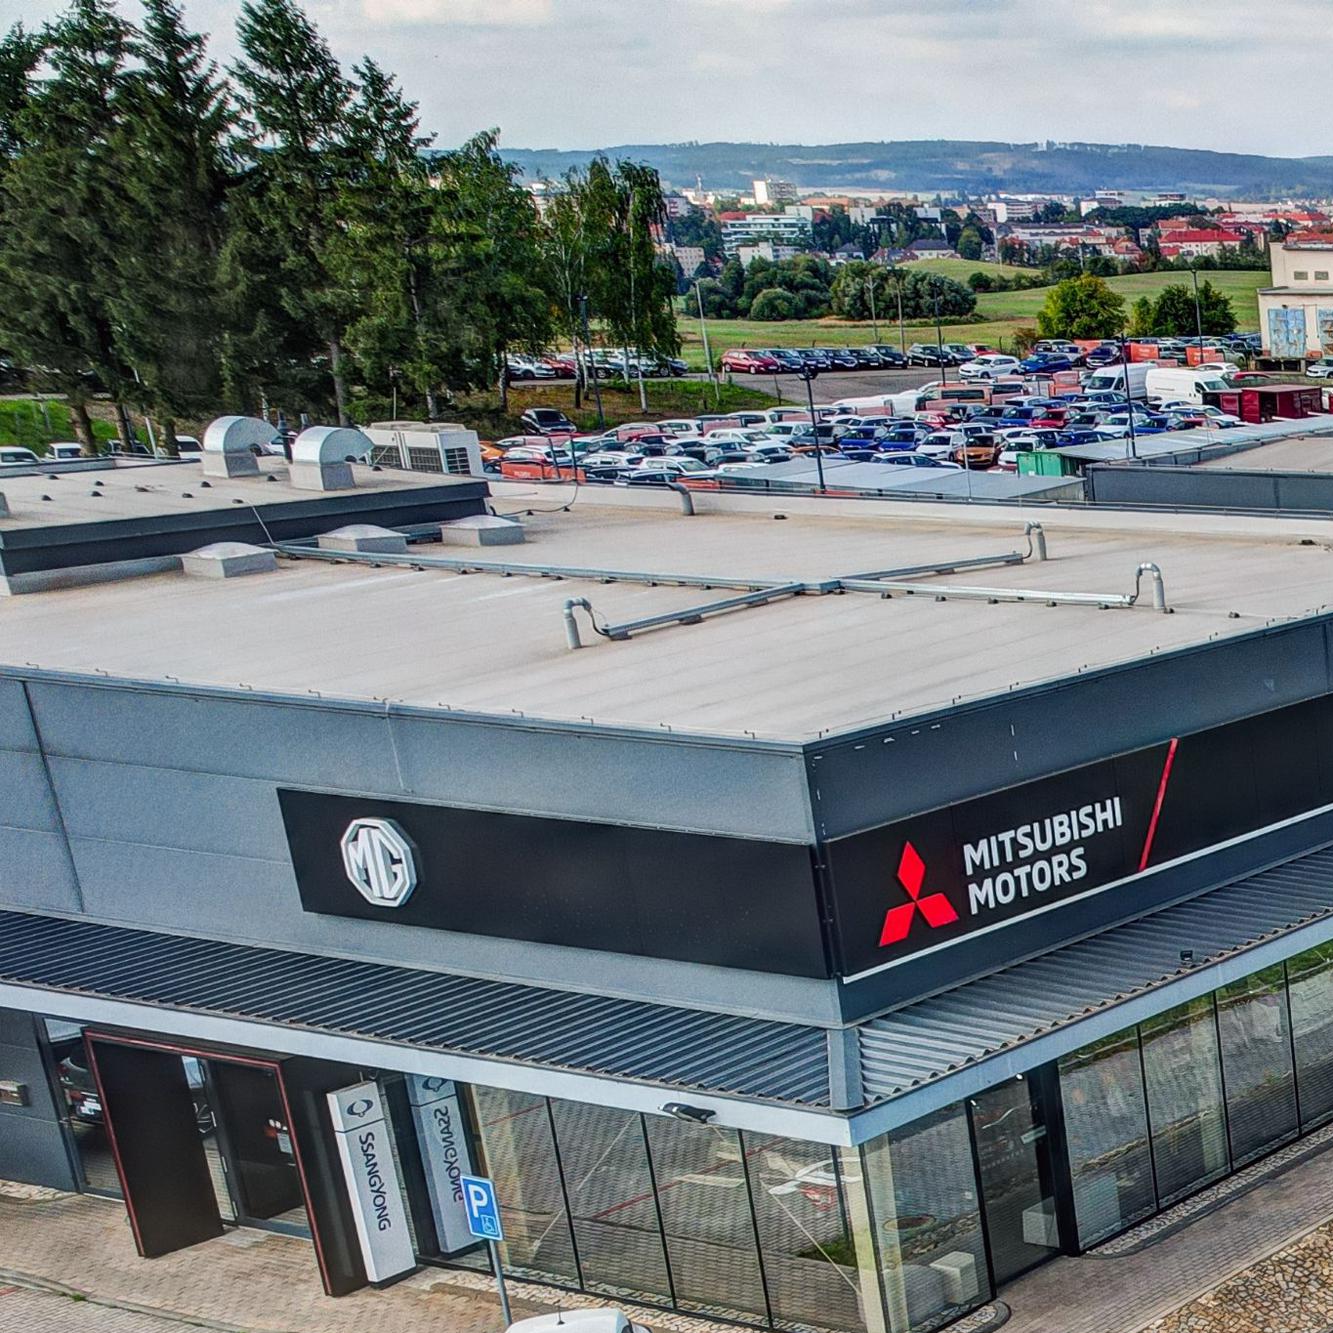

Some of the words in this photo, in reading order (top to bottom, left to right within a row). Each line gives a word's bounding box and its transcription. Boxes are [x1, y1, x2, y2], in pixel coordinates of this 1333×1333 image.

[347, 826, 404, 900] MG
[963, 796, 1123, 876] MITSUBISHI
[968, 846, 1087, 915] MOTORS
[359, 1132, 392, 1231] SSANGYONG
[467, 1184, 488, 1218] P
